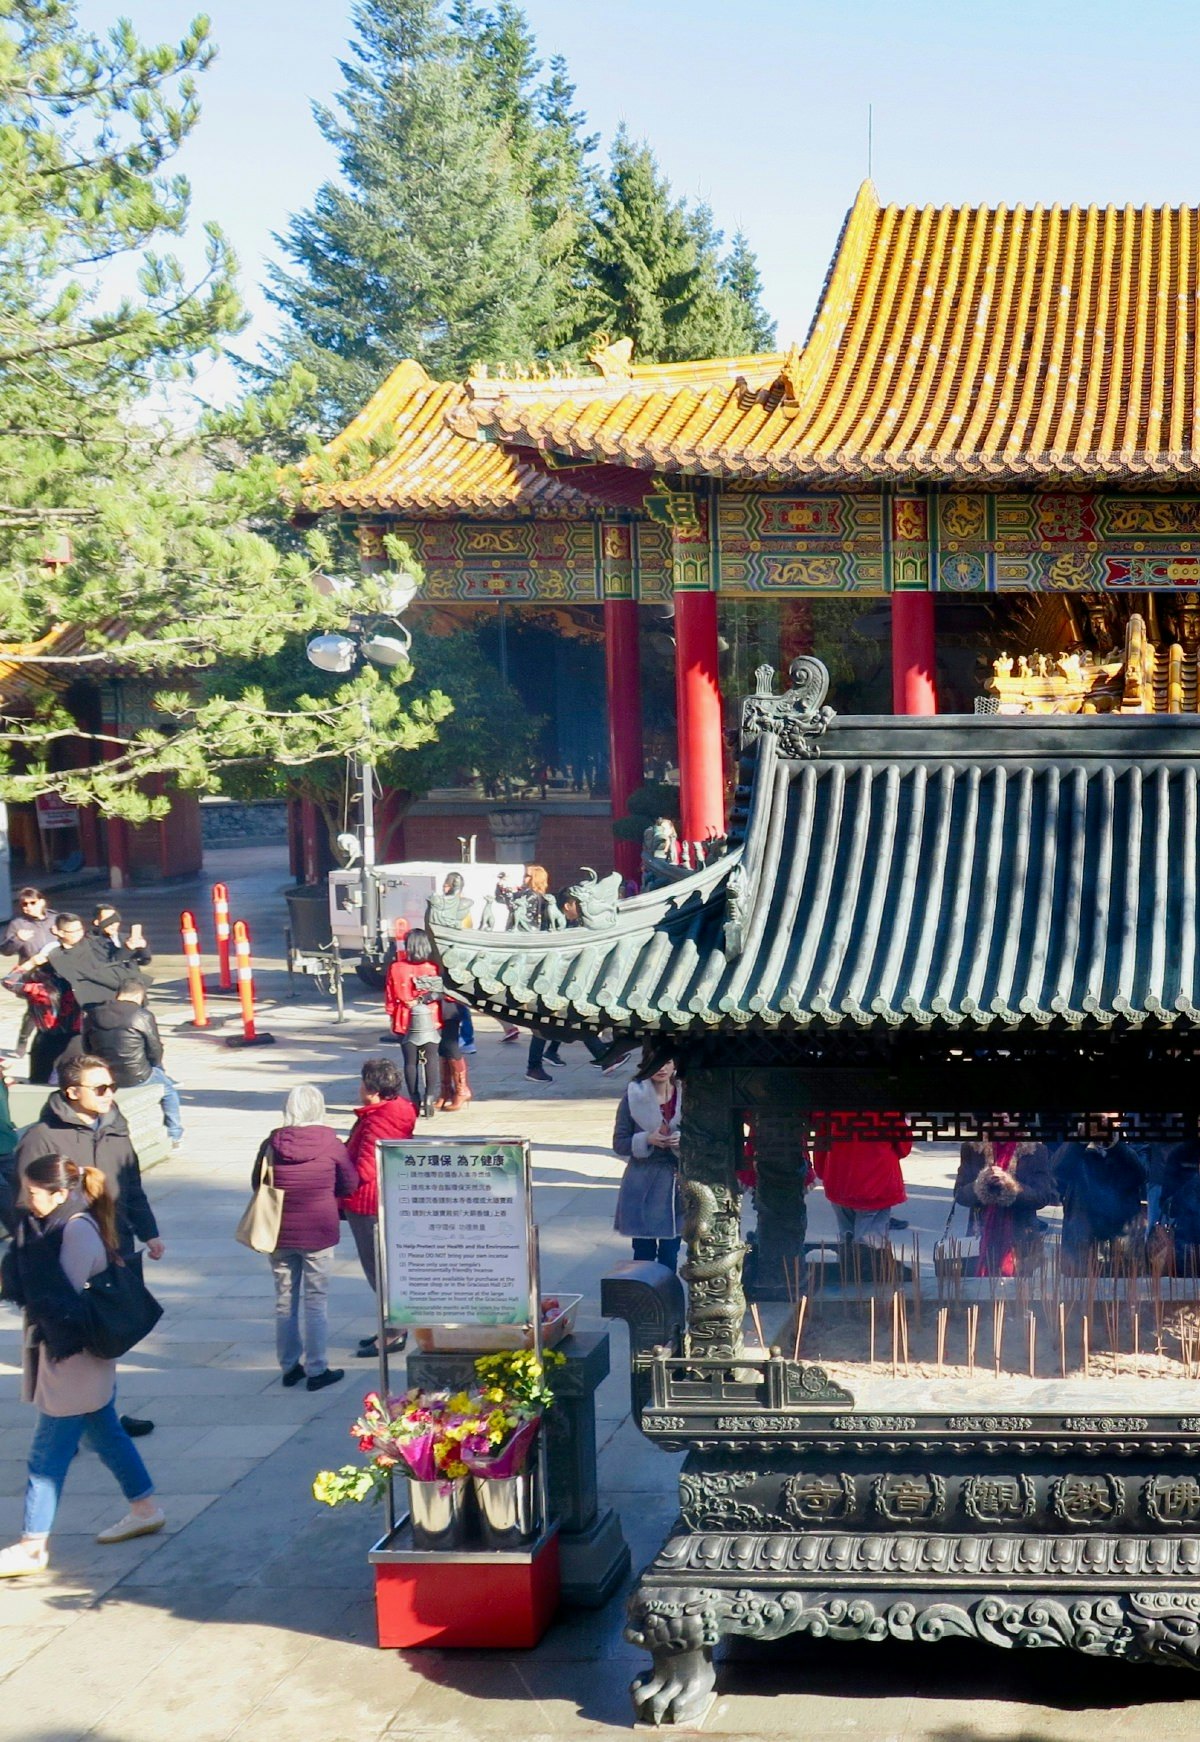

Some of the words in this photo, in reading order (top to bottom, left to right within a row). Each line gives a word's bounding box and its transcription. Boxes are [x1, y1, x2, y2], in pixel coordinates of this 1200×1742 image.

[405, 1155, 452, 1166] 為了環保
[457, 1155, 504, 1166] 為了健康
